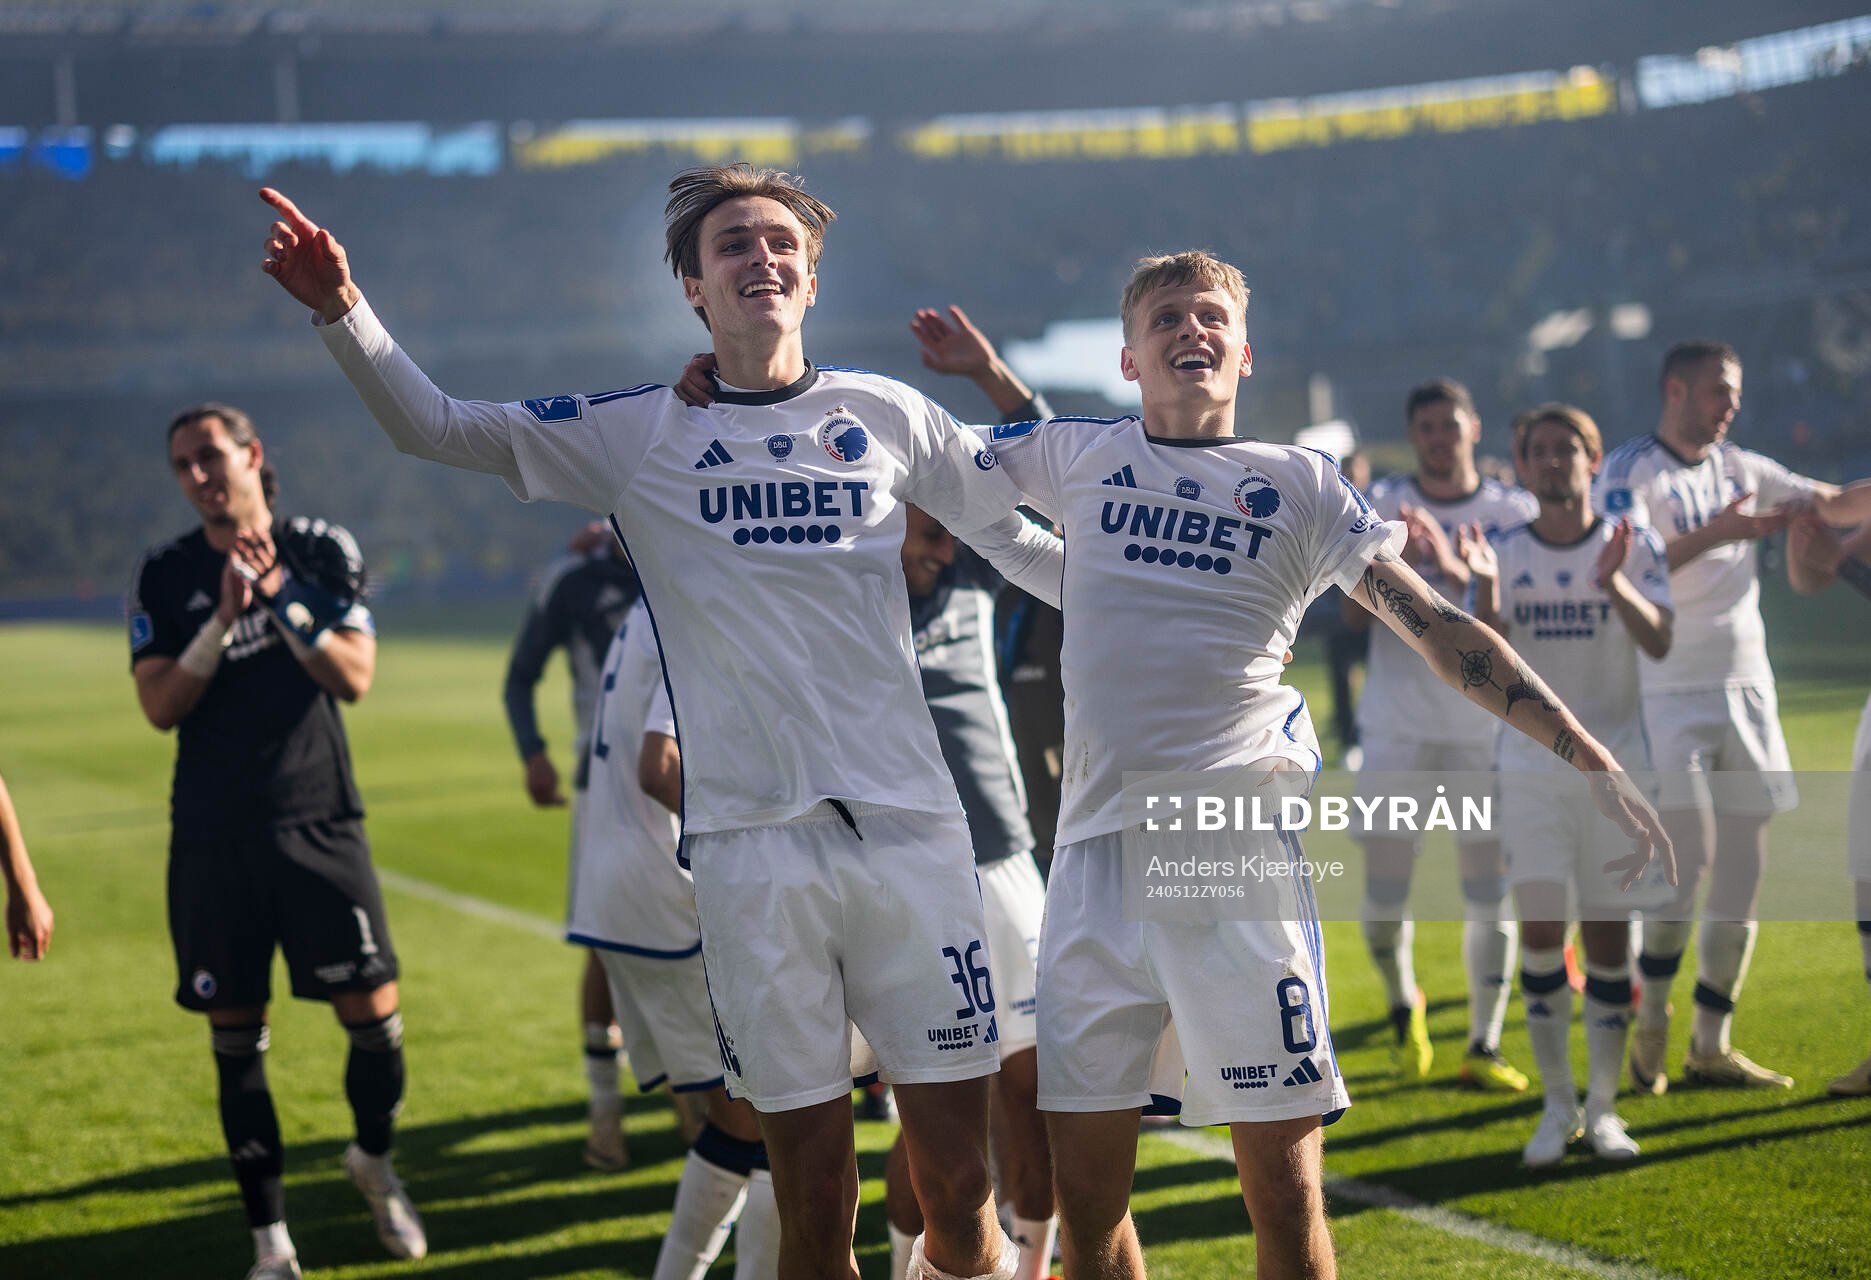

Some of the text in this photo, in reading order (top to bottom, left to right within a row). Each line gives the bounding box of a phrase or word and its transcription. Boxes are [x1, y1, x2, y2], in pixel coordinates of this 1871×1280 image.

[700, 482, 869, 523] UNIBET
[1101, 501, 1273, 560] UNIBET
[1514, 602, 1611, 626] UNIBET
[352, 906, 378, 954] 1
[942, 940, 995, 1020] 36
[928, 1023, 979, 1042] UNIBET
[1276, 976, 1317, 1054] 8
[1220, 1064, 1278, 1081] UNIBET
